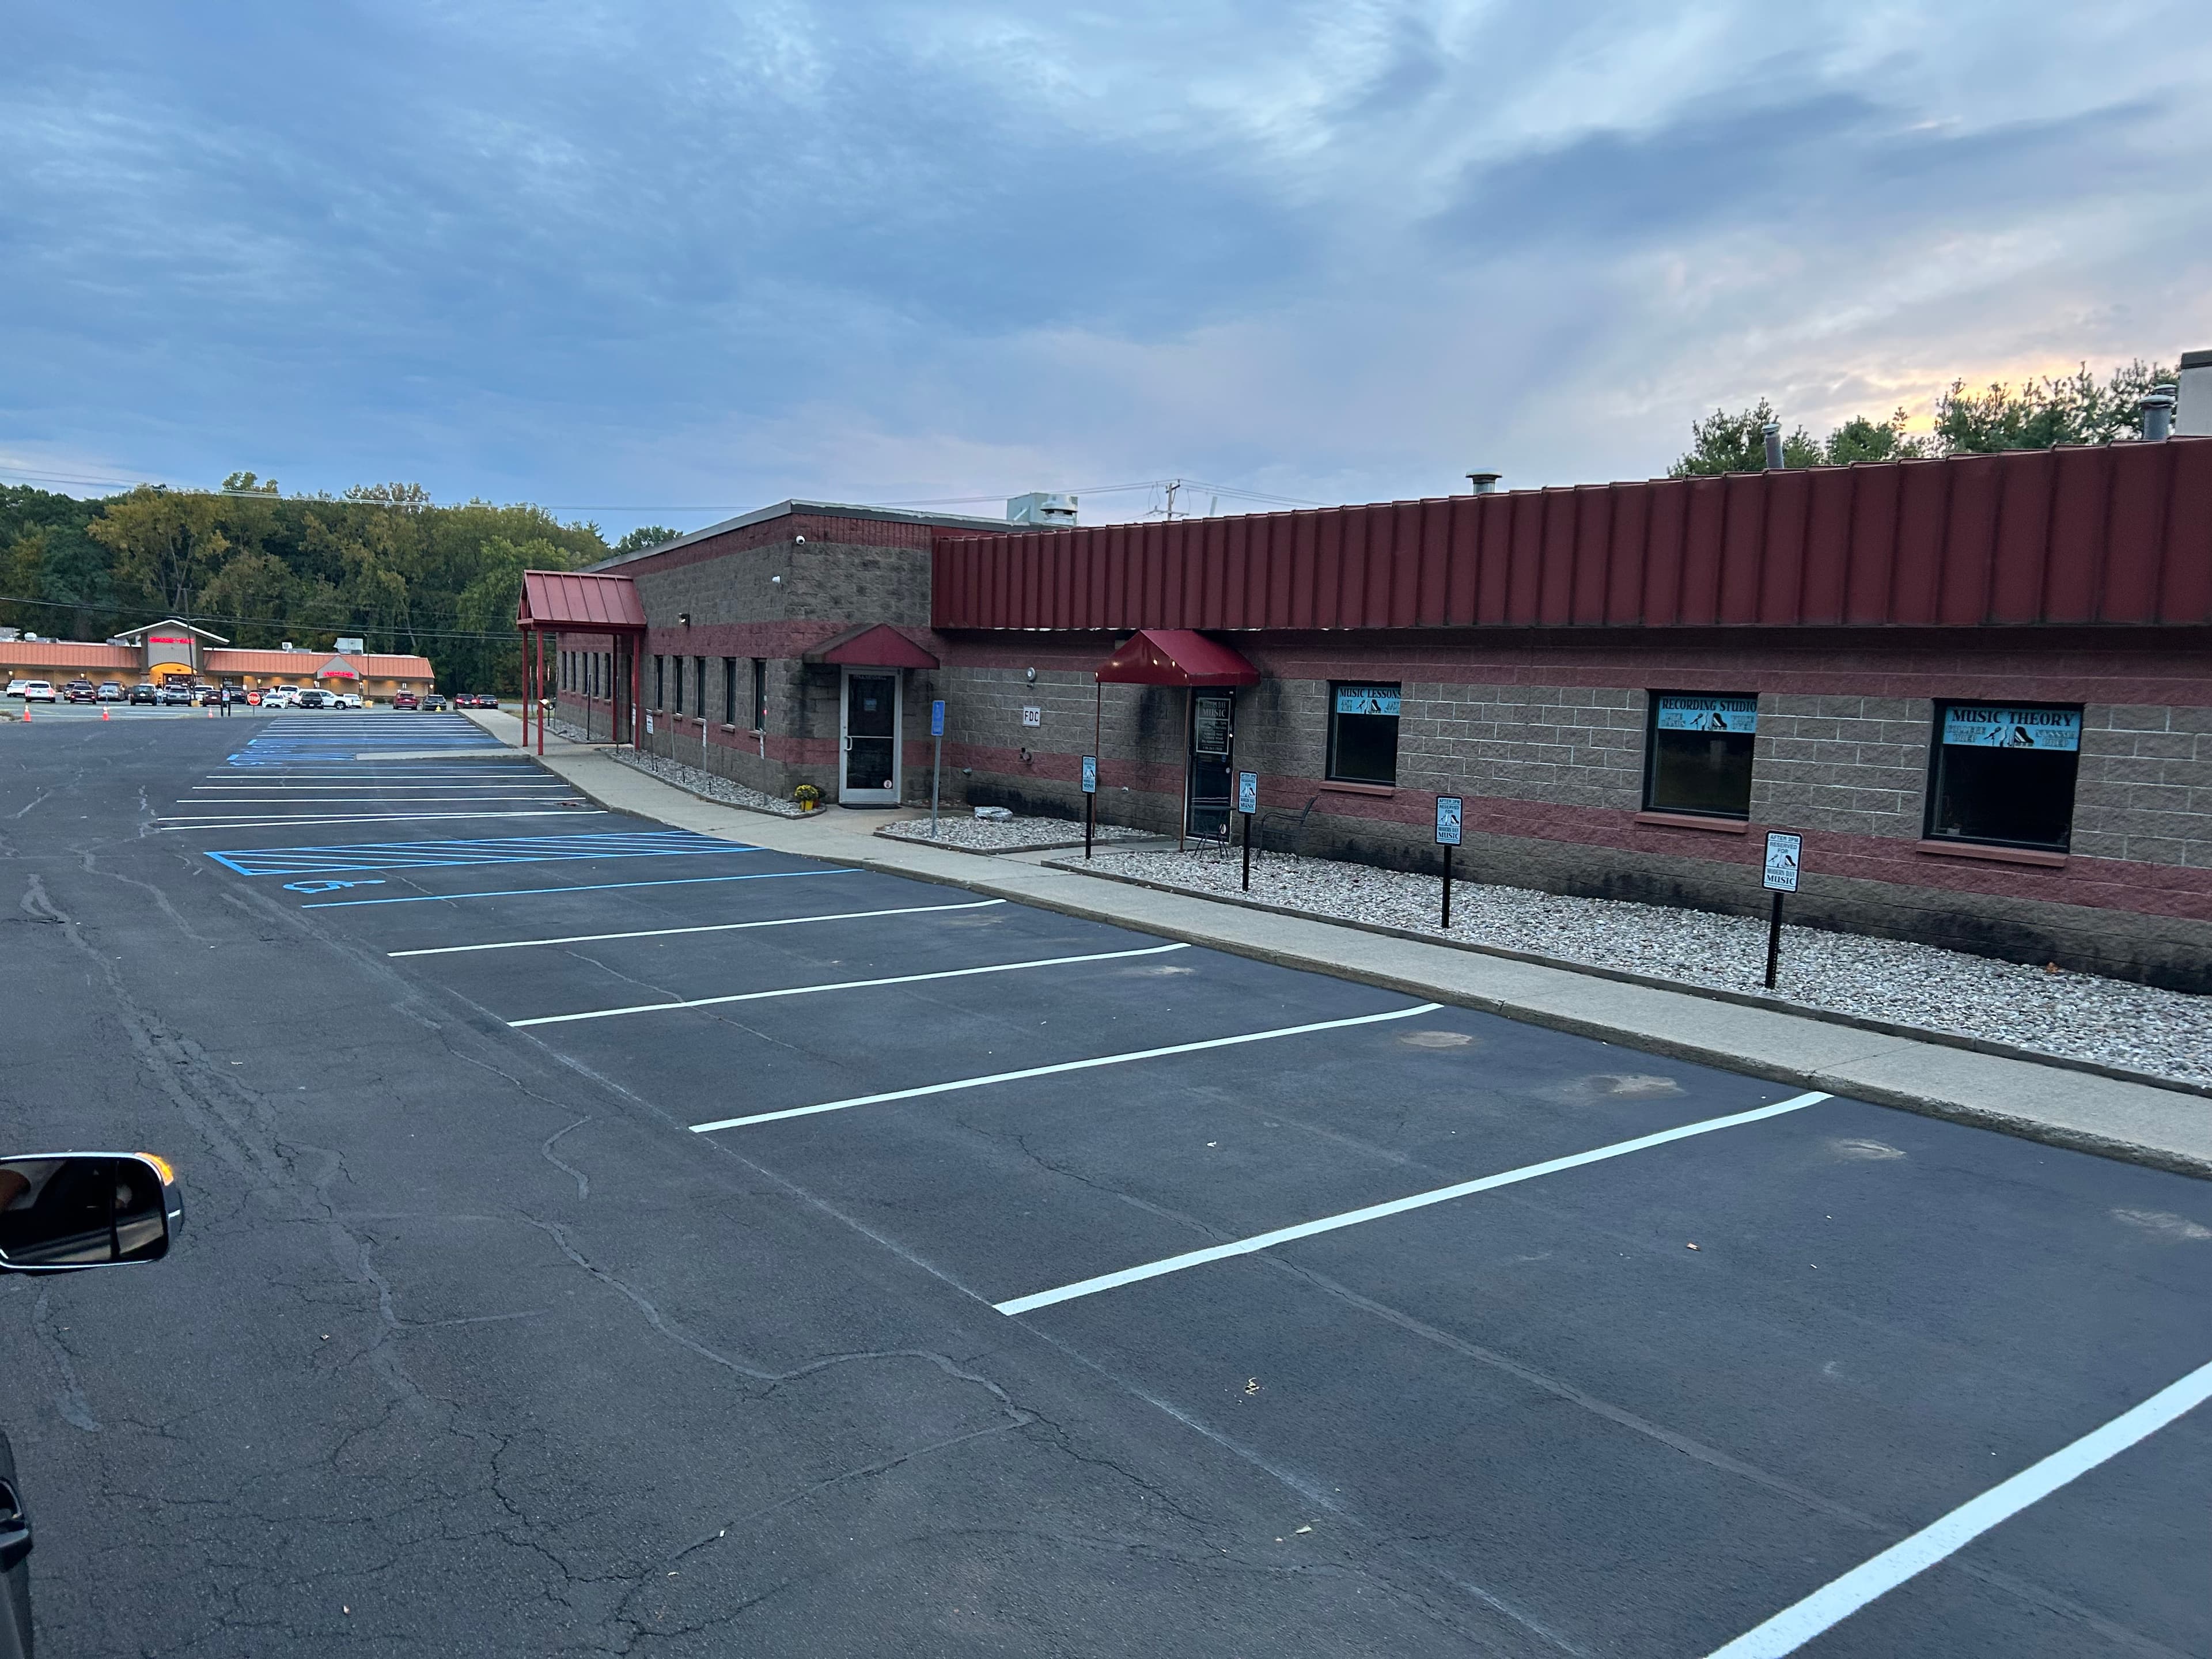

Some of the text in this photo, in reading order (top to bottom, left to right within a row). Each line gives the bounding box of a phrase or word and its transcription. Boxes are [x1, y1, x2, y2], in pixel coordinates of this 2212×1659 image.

[1339, 688, 1401, 699] MUSIC LESSONS
[1662, 698, 1757, 713] RECORDING STUDIO
[1025, 710, 1039, 722] FDC
[1202, 709, 1226, 717] MUSIC
[1952, 709, 2075, 726] MUSIC THEORY
[1769, 842, 1798, 850] RESERVED
[1766, 874, 1795, 885] MUSIC
